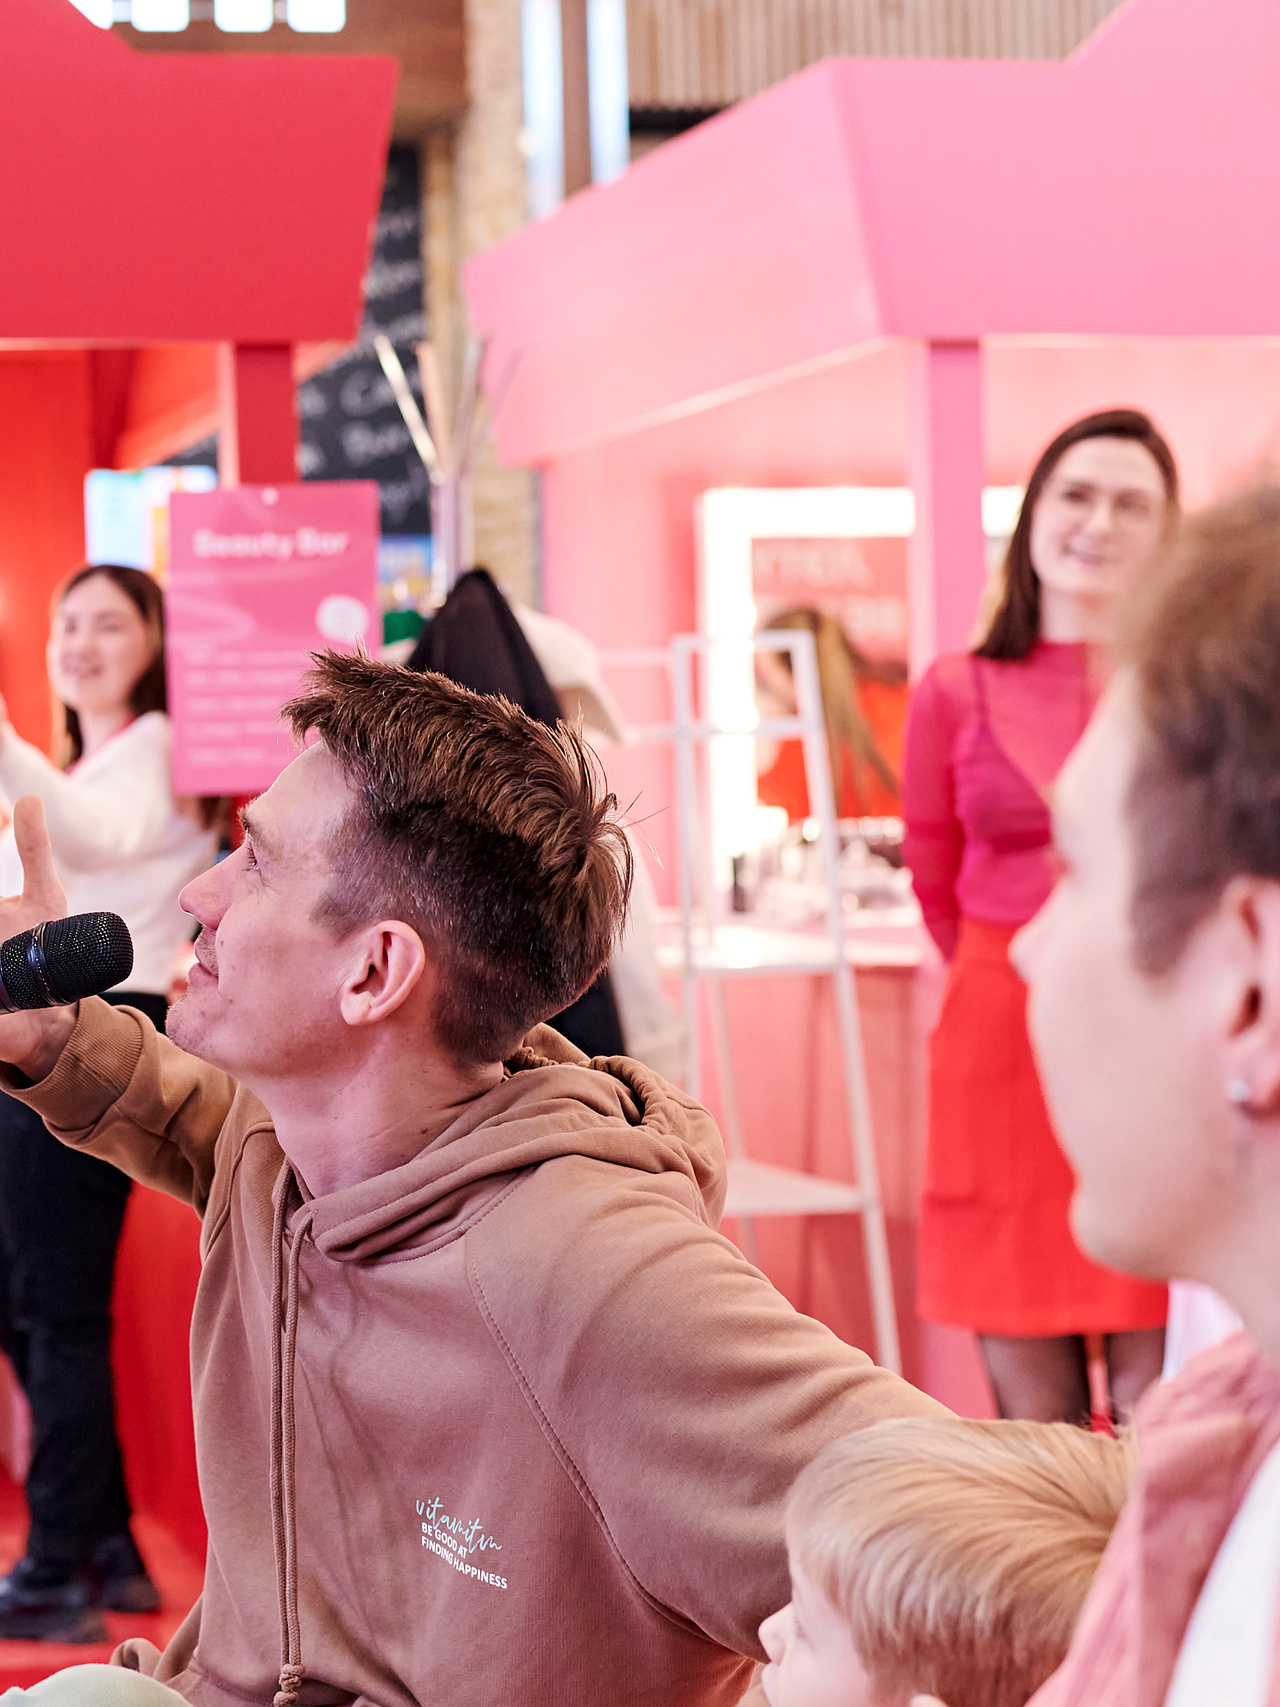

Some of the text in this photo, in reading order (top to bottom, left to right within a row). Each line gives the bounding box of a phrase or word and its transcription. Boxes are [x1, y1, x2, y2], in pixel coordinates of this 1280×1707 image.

[192, 526, 349, 561] Beauty Bar
[421, 1522, 468, 1559] BE GOOD AT
[421, 1535, 508, 1589] FINDING HAPPINESS
